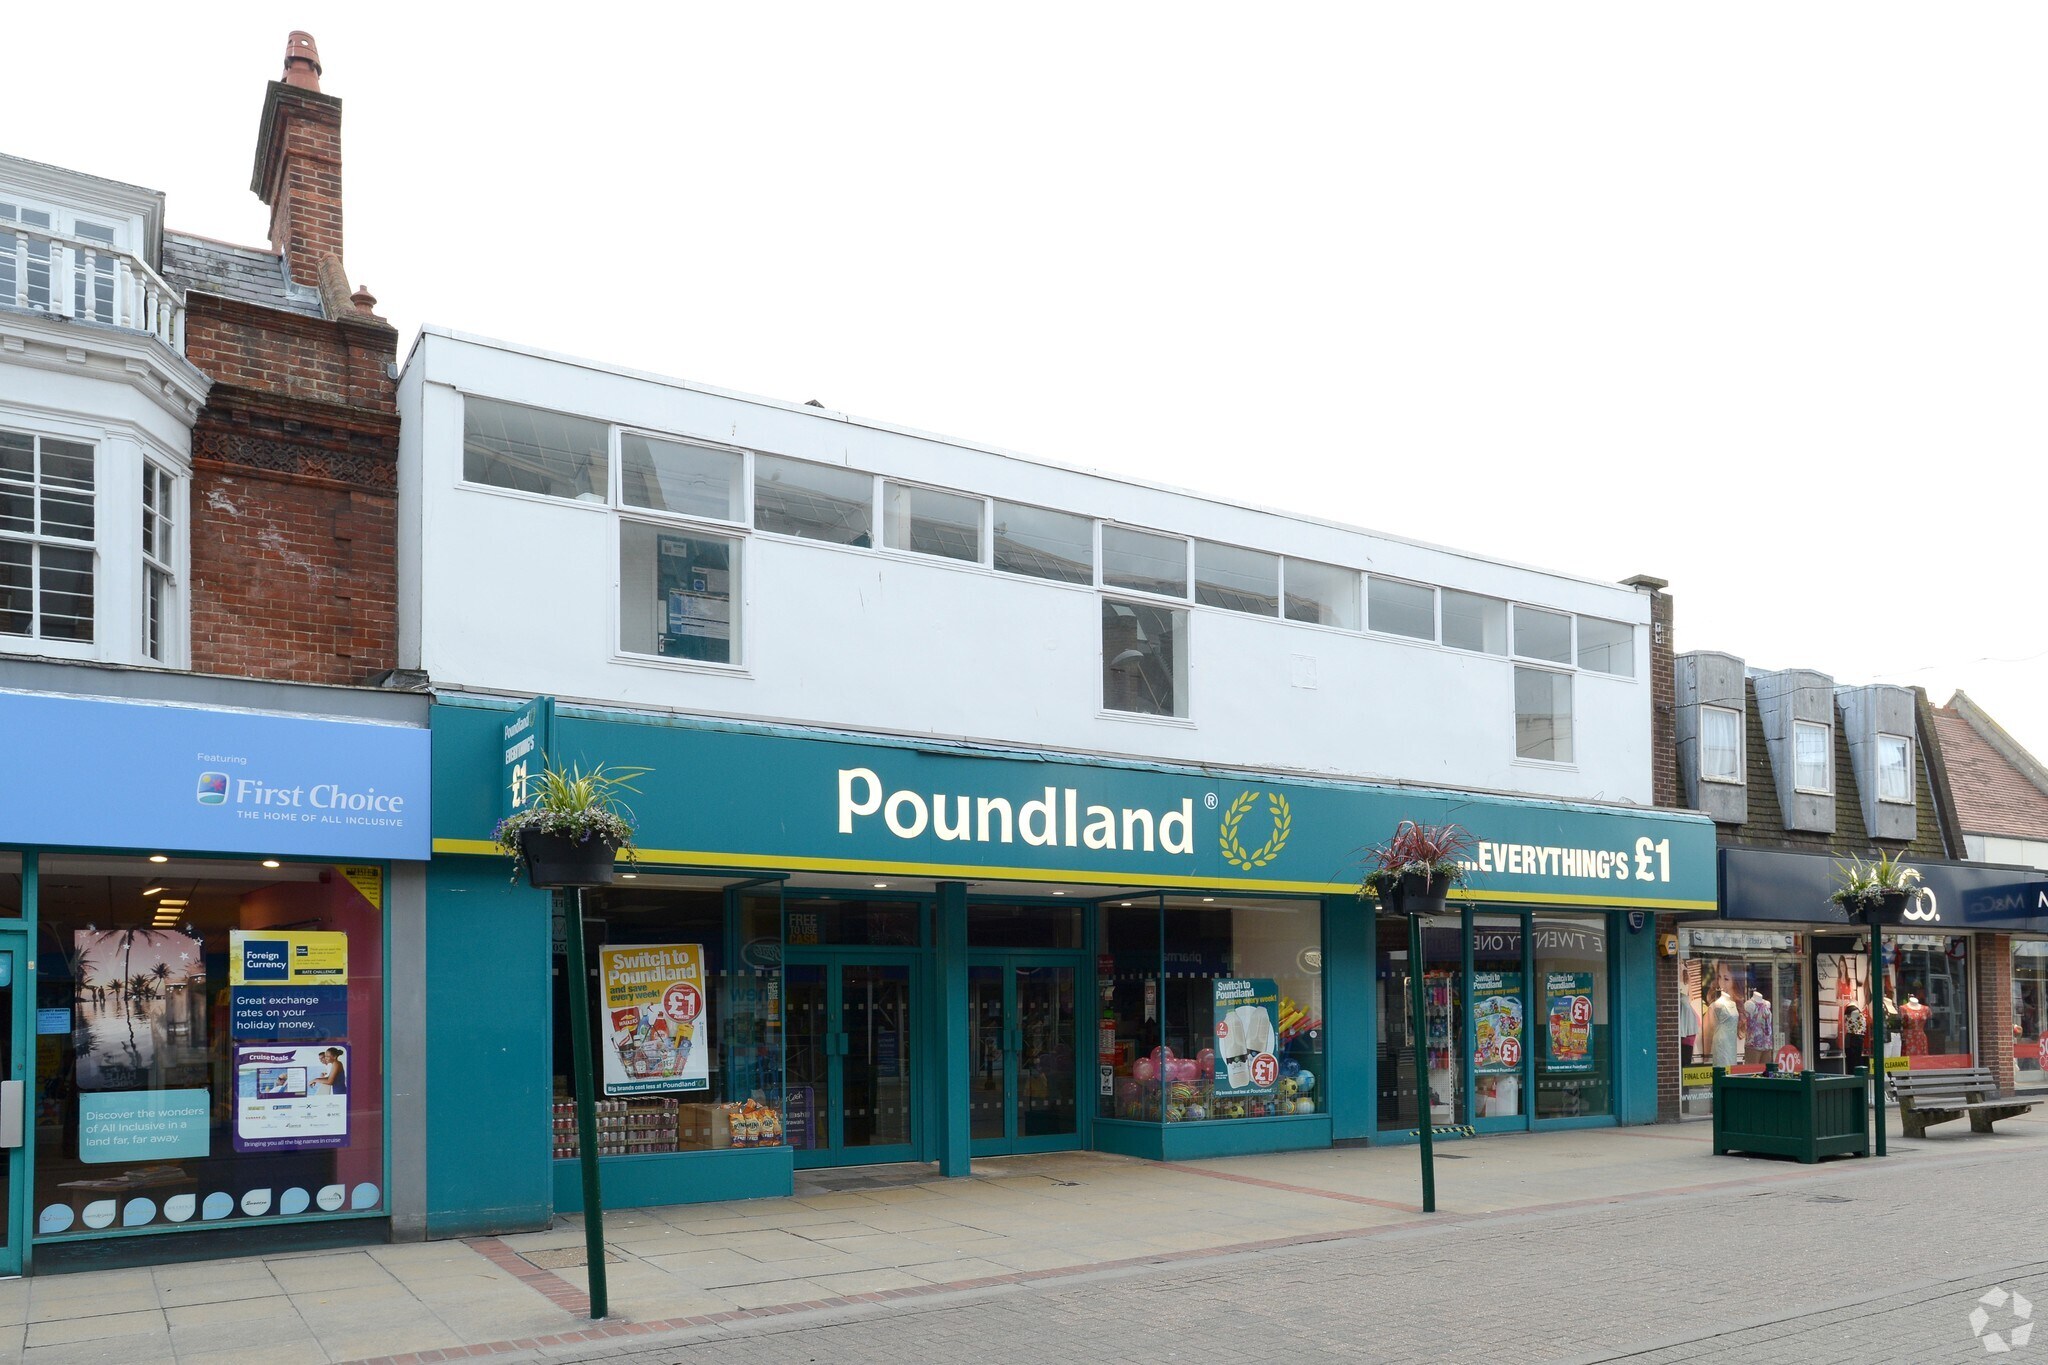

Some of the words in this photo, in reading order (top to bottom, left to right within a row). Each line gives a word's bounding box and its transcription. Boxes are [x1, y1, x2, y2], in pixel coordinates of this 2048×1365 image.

[504, 710, 530, 740] Poundland
[197, 752, 247, 765] Featuring
[512, 760, 527, 808] £1
[236, 778, 304, 807] First
[309, 784, 404, 813] Choice
[838, 767, 1194, 855] Poundland
[237, 810, 259, 820] THE
[263, 812, 297, 822] HOME
[301, 814, 317, 823] OF
[321, 816, 342, 824] ALL
[346, 817, 403, 827] INCLUSIVE
[1634, 836, 1670, 883] £1
[789, 913, 817, 926] FREE
[790, 925, 799, 935] TO
[801, 925, 817, 935] USE
[789, 934, 817, 945] CASH
[246, 951, 279, 961] Foreign
[613, 950, 671, 970] Switch
[672, 949, 690, 964] to
[246, 960, 287, 970] Currency
[608, 963, 697, 986] Poundland
[1475, 974, 1494, 983] Switch
[1549, 975, 1567, 983] Switch
[610, 985, 626, 994] and
[628, 984, 648, 993] save
[1218, 981, 1243, 991] Switch
[1243, 980, 1251, 989] to
[1473, 980, 1502, 990] Poundland
[1547, 980, 1575, 990] Poundland
[611, 992, 634, 1001] every
[635, 989, 660, 1000] week!
[1215, 988, 1255, 1000] Poundland
[1259, 994, 1277, 1003] week!
[236, 996, 266, 1005] Great
[269, 996, 319, 1006] exchange
[668, 992, 696, 1016] £1
[236, 1008, 263, 1017] rates
[266, 1009, 279, 1017] on
[282, 1009, 306, 1018] your
[1574, 1003, 1589, 1020] £1
[236, 1021, 276, 1030] holiday
[278, 1021, 316, 1030] money.
[1219, 1022, 1225, 1031] 2
[1503, 1044, 1518, 1063] £1
[1885, 1060, 1908, 1068] CLEARANCE
[1255, 1061, 1275, 1082] £1
[617, 1083, 634, 1091] brands
[86, 1111, 134, 1121] Discover
[137, 1109, 155, 1118] the
[158, 1107, 204, 1117] wonders
[86, 1123, 99, 1134] of
[100, 1123, 115, 1133] All
[119, 1121, 165, 1132] Inclusive
[168, 1121, 178, 1129] in
[180, 1121, 187, 1129] a
[86, 1137, 110, 1147] land
[113, 1136, 129, 1146] far,
[133, 1135, 147, 1144] far
[150, 1135, 180, 1144] away.
[244, 1140, 267, 1148] Bringing
